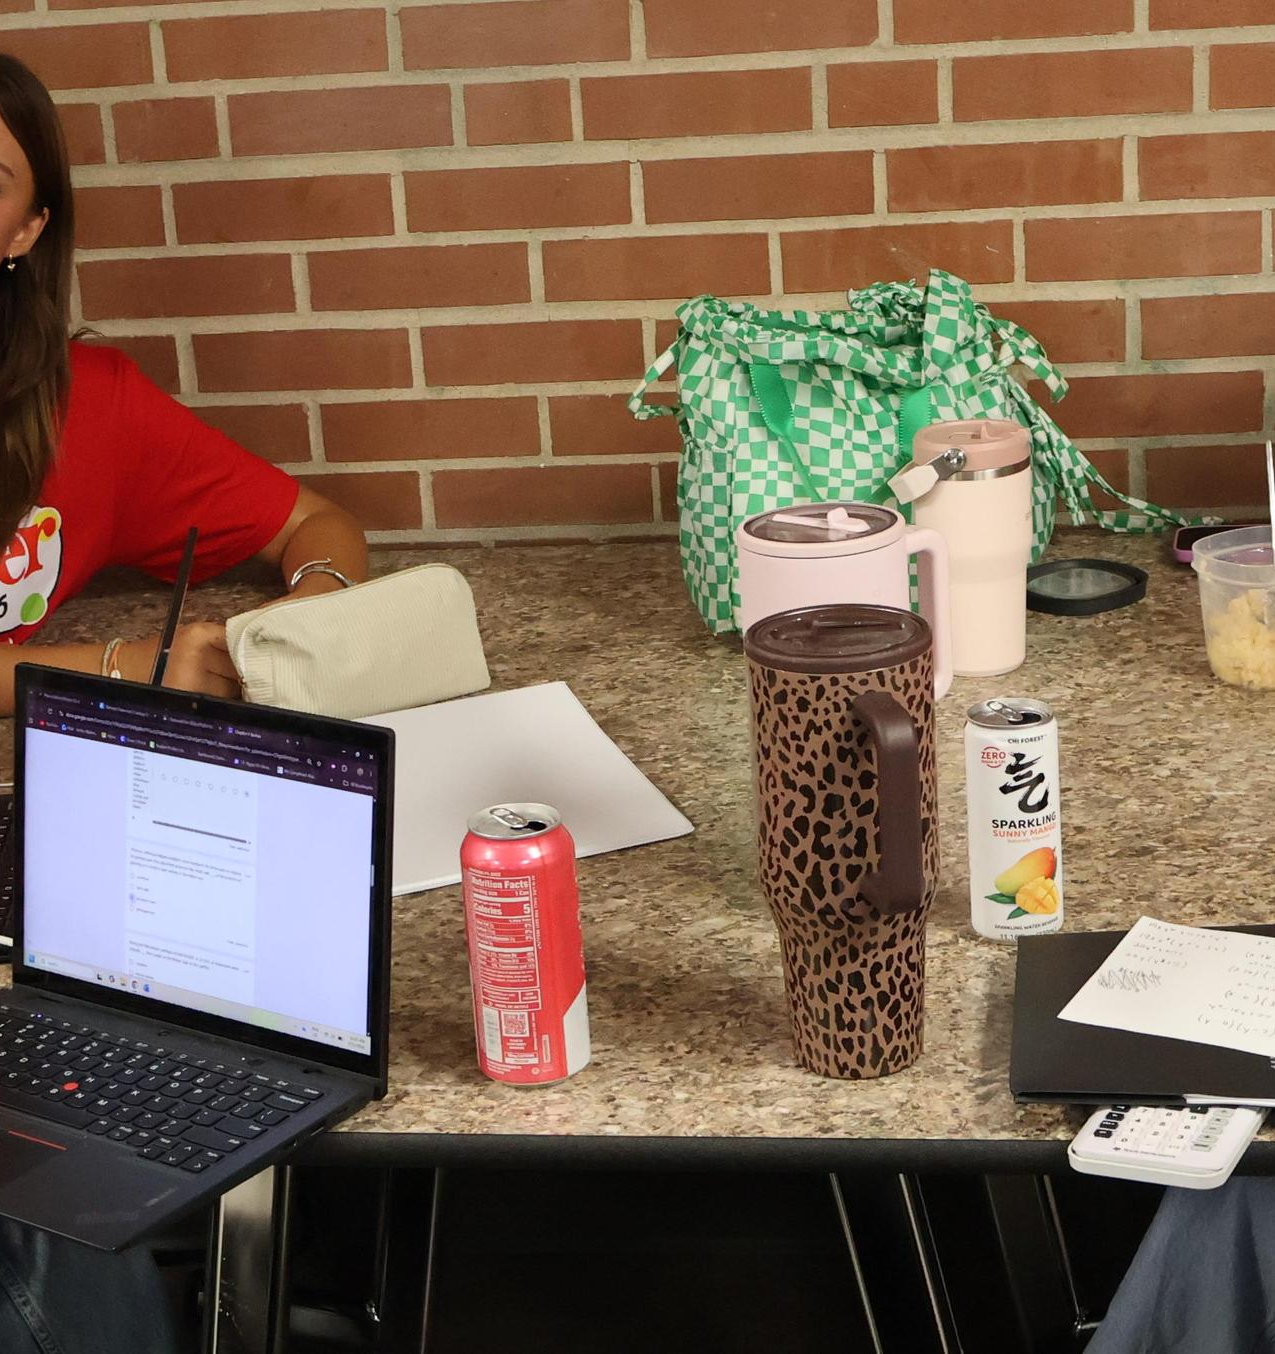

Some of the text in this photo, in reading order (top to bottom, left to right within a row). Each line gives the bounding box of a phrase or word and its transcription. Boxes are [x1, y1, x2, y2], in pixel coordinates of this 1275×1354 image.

[1021, 735, 1044, 744] FOREST
[981, 751, 1006, 760] ZERO
[991, 811, 1057, 830] SPARKLING
[992, 829, 1028, 838] SUNNY
[504, 880, 529, 889] Facts
[523, 903, 531, 914] 5
